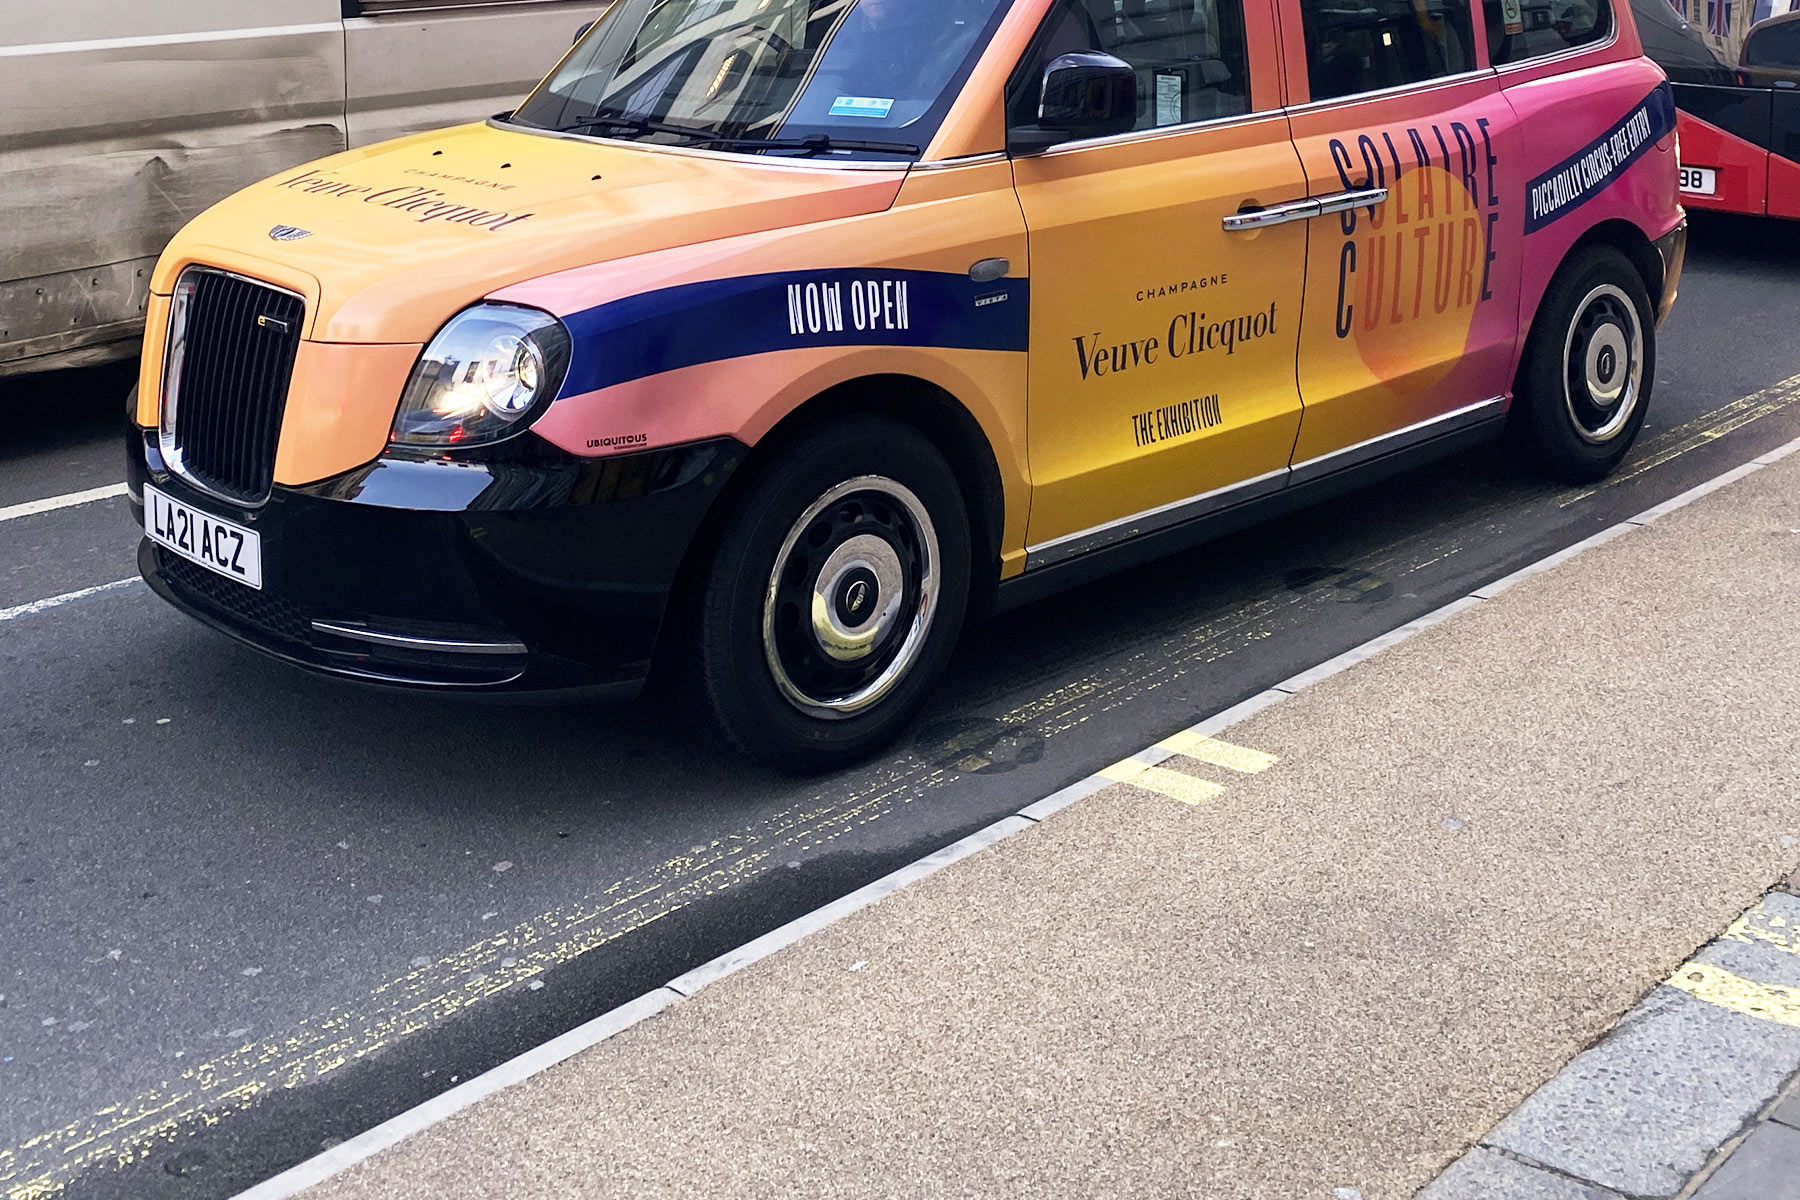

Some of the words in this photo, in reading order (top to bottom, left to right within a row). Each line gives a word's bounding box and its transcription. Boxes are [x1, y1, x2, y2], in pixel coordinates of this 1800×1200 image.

[404, 169, 516, 191] CHAMPAGNE
[1329, 118, 1499, 235] SOLAIRE
[1532, 163, 1583, 220] PICCADILLY
[1626, 106, 1651, 151] ENTRY
[275, 169, 372, 197] Veuve
[364, 186, 535, 231] Clicquot
[1136, 274, 1228, 301] CHAMPAGNE
[1336, 212, 1499, 338] CULTURE
[788, 281, 843, 334] NOW
[851, 280, 909, 331] OPEN
[1072, 332, 1159, 380] Veuve
[1168, 301, 1280, 358] Clicquot
[586, 433, 647, 448] UBIQUITOUS
[1132, 411, 1156, 447] THE
[1156, 394, 1222, 441] EXHIBITION
[154, 495, 195, 554] LA21
[202, 520, 245, 575] ACZ
